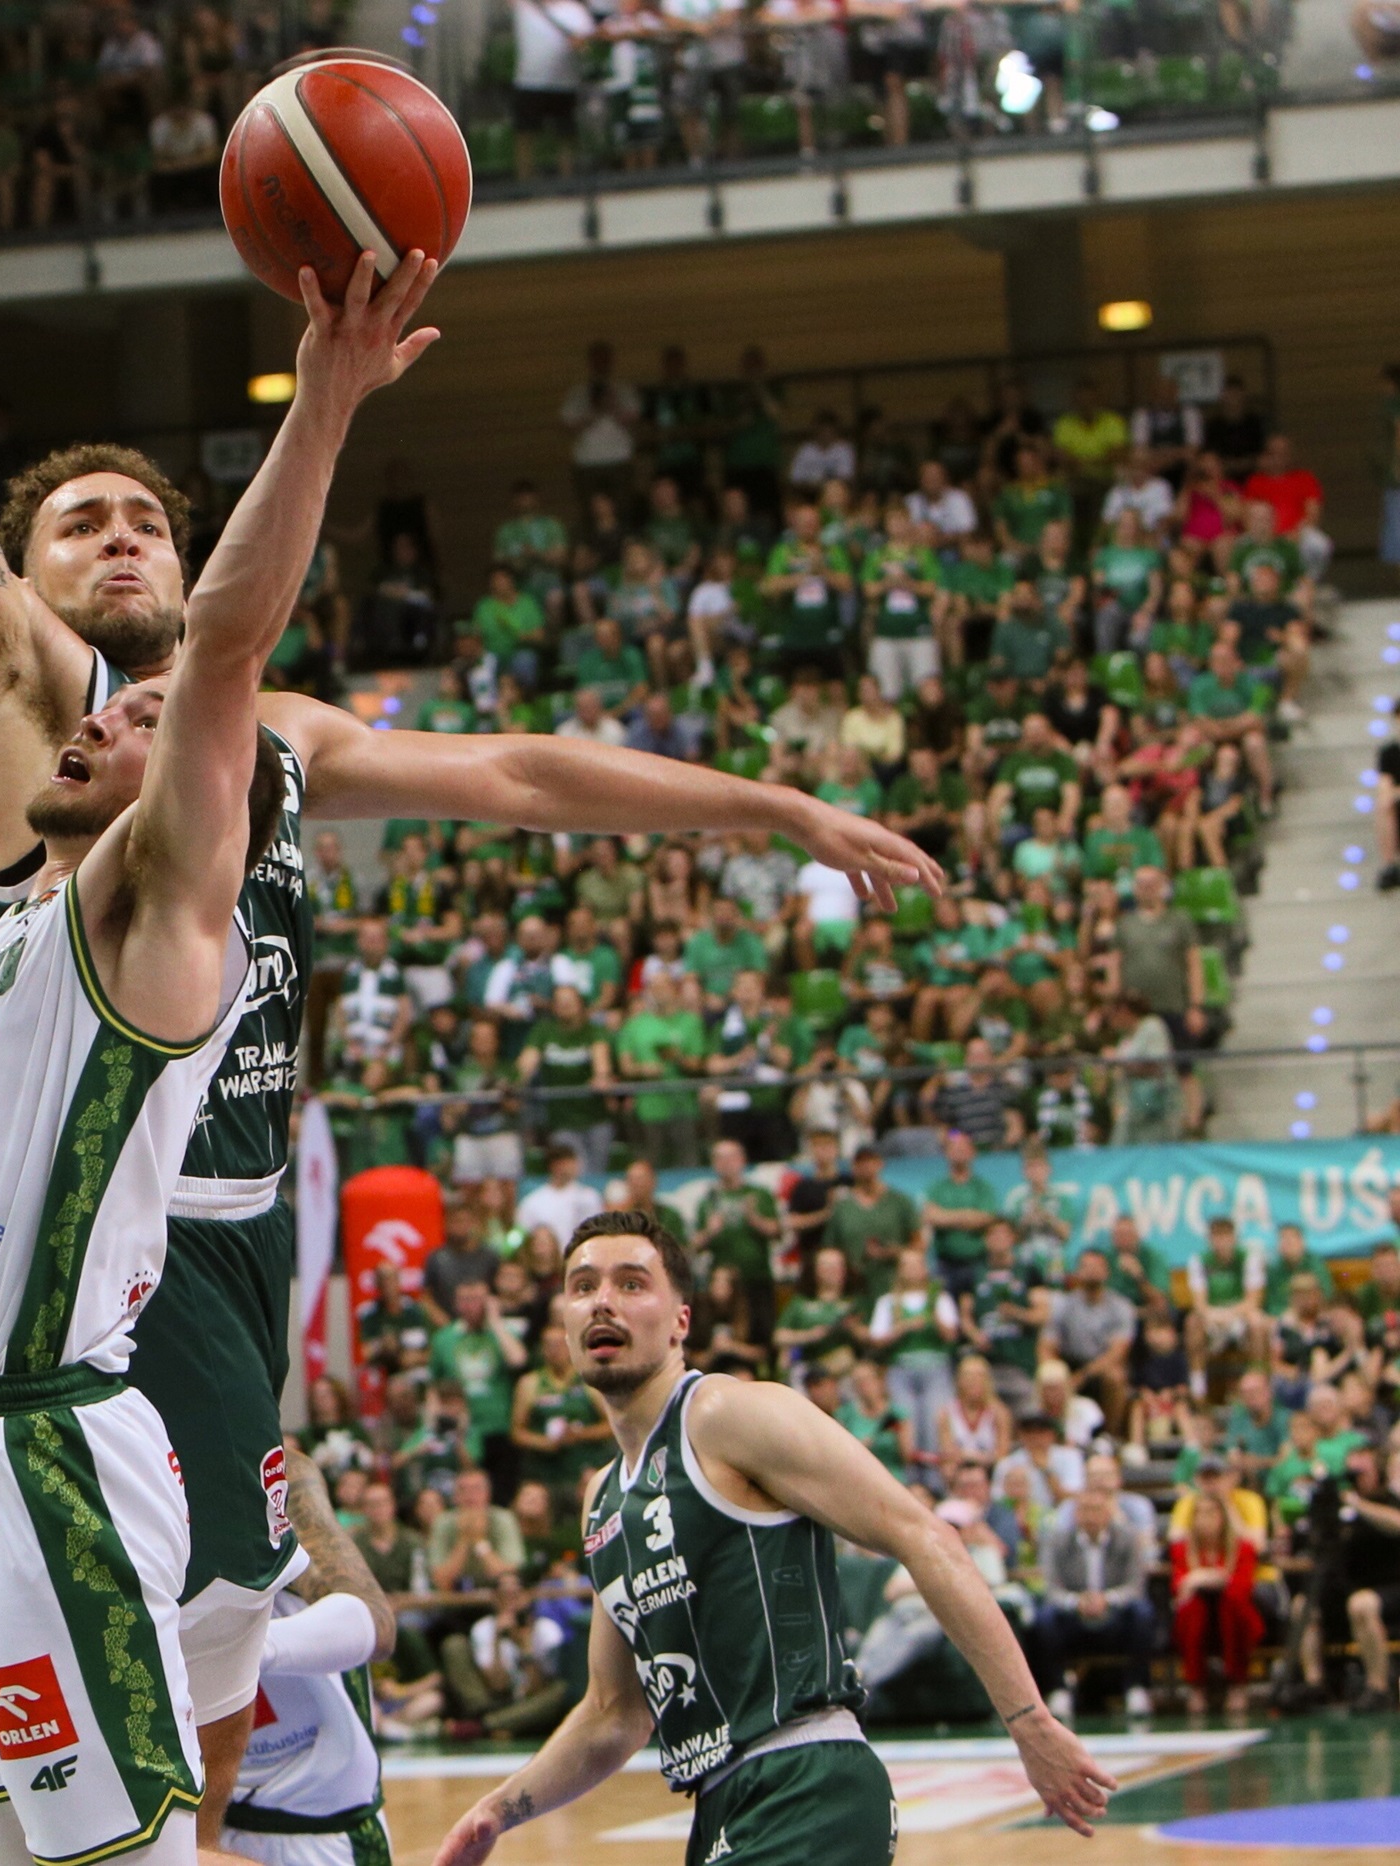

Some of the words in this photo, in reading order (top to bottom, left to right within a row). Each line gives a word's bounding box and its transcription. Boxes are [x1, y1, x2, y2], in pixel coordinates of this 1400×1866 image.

[1300, 1147, 1398, 1233] UŚ
[642, 1494, 675, 1552] 3
[637, 1580, 698, 1616] ERMIKA
[660, 1722, 730, 1769] AMWAJE
[29, 1754, 79, 1793] 4F
